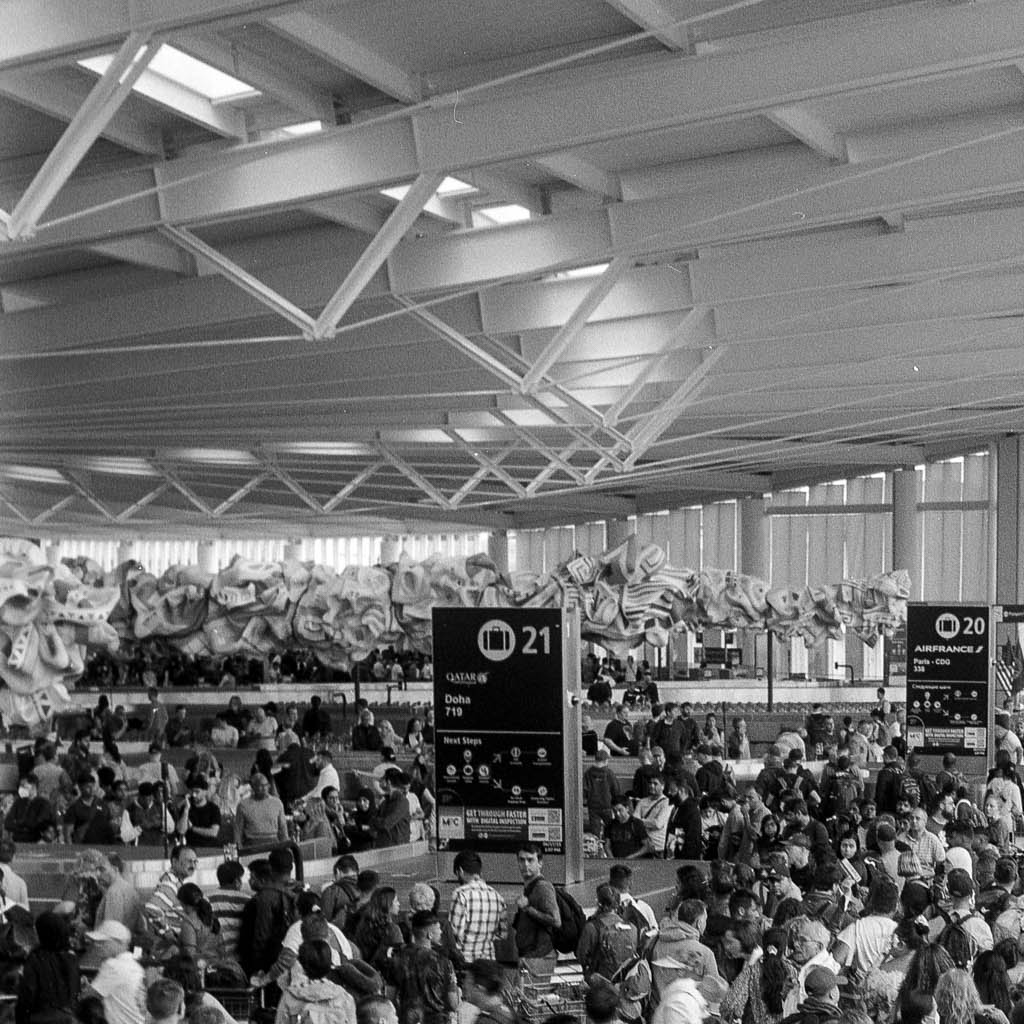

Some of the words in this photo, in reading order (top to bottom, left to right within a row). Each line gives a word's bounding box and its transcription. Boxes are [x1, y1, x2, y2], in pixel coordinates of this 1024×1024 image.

[962, 616, 986, 635] 20
[521, 625, 551, 655] 21
[914, 644, 974, 653] AIRFRANCE
[446, 672, 477, 683] QATAR
[444, 693, 472, 705] Doha
[445, 706, 463, 717] 719
[443, 736, 461, 745] Next
[462, 736, 482, 747] Steps
[466, 809, 478, 817] GET
